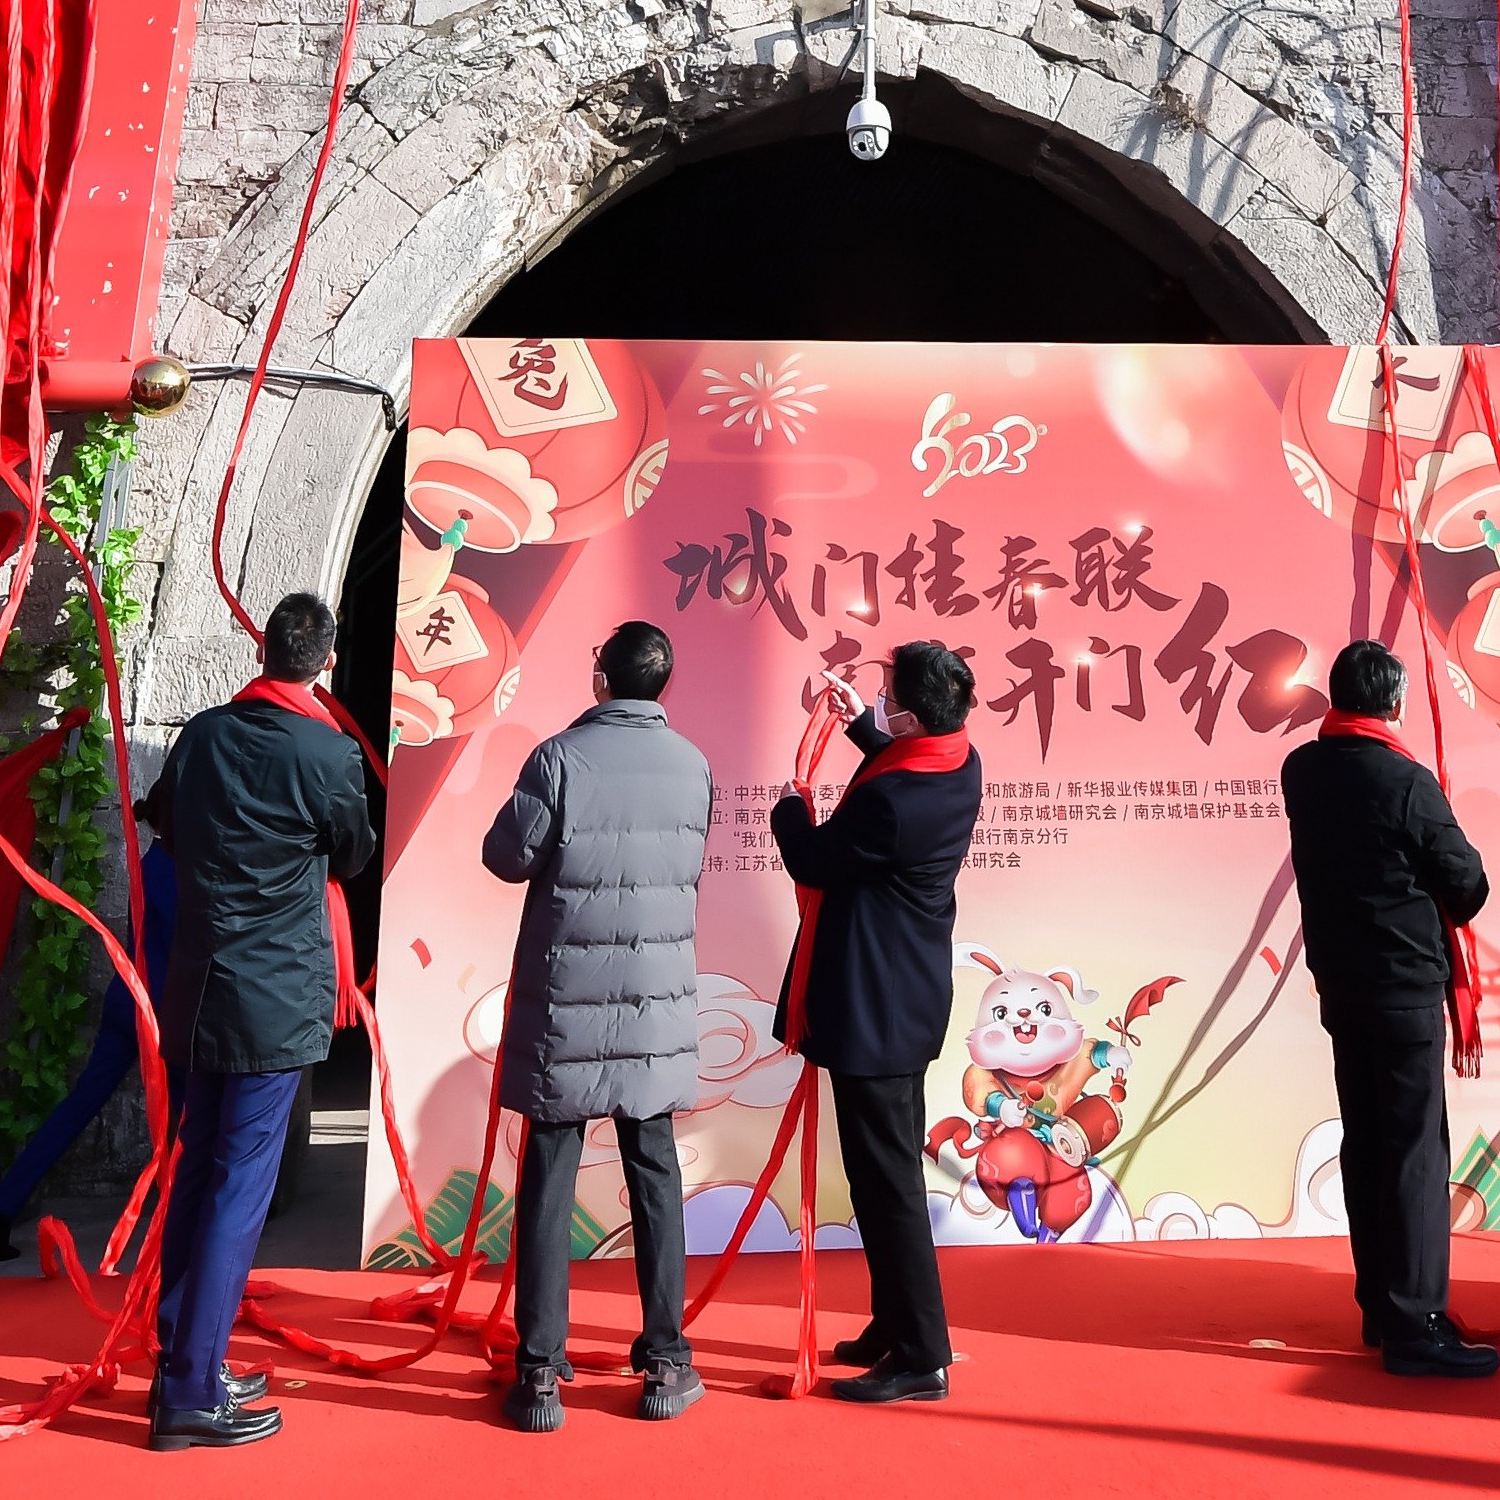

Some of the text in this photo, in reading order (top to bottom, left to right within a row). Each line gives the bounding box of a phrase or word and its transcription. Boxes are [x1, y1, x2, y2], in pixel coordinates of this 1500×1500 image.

[416, 606, 455, 657] 年
[662, 506, 1183, 641] 城门挂春联
[800, 581, 1330, 765] 南开门红
